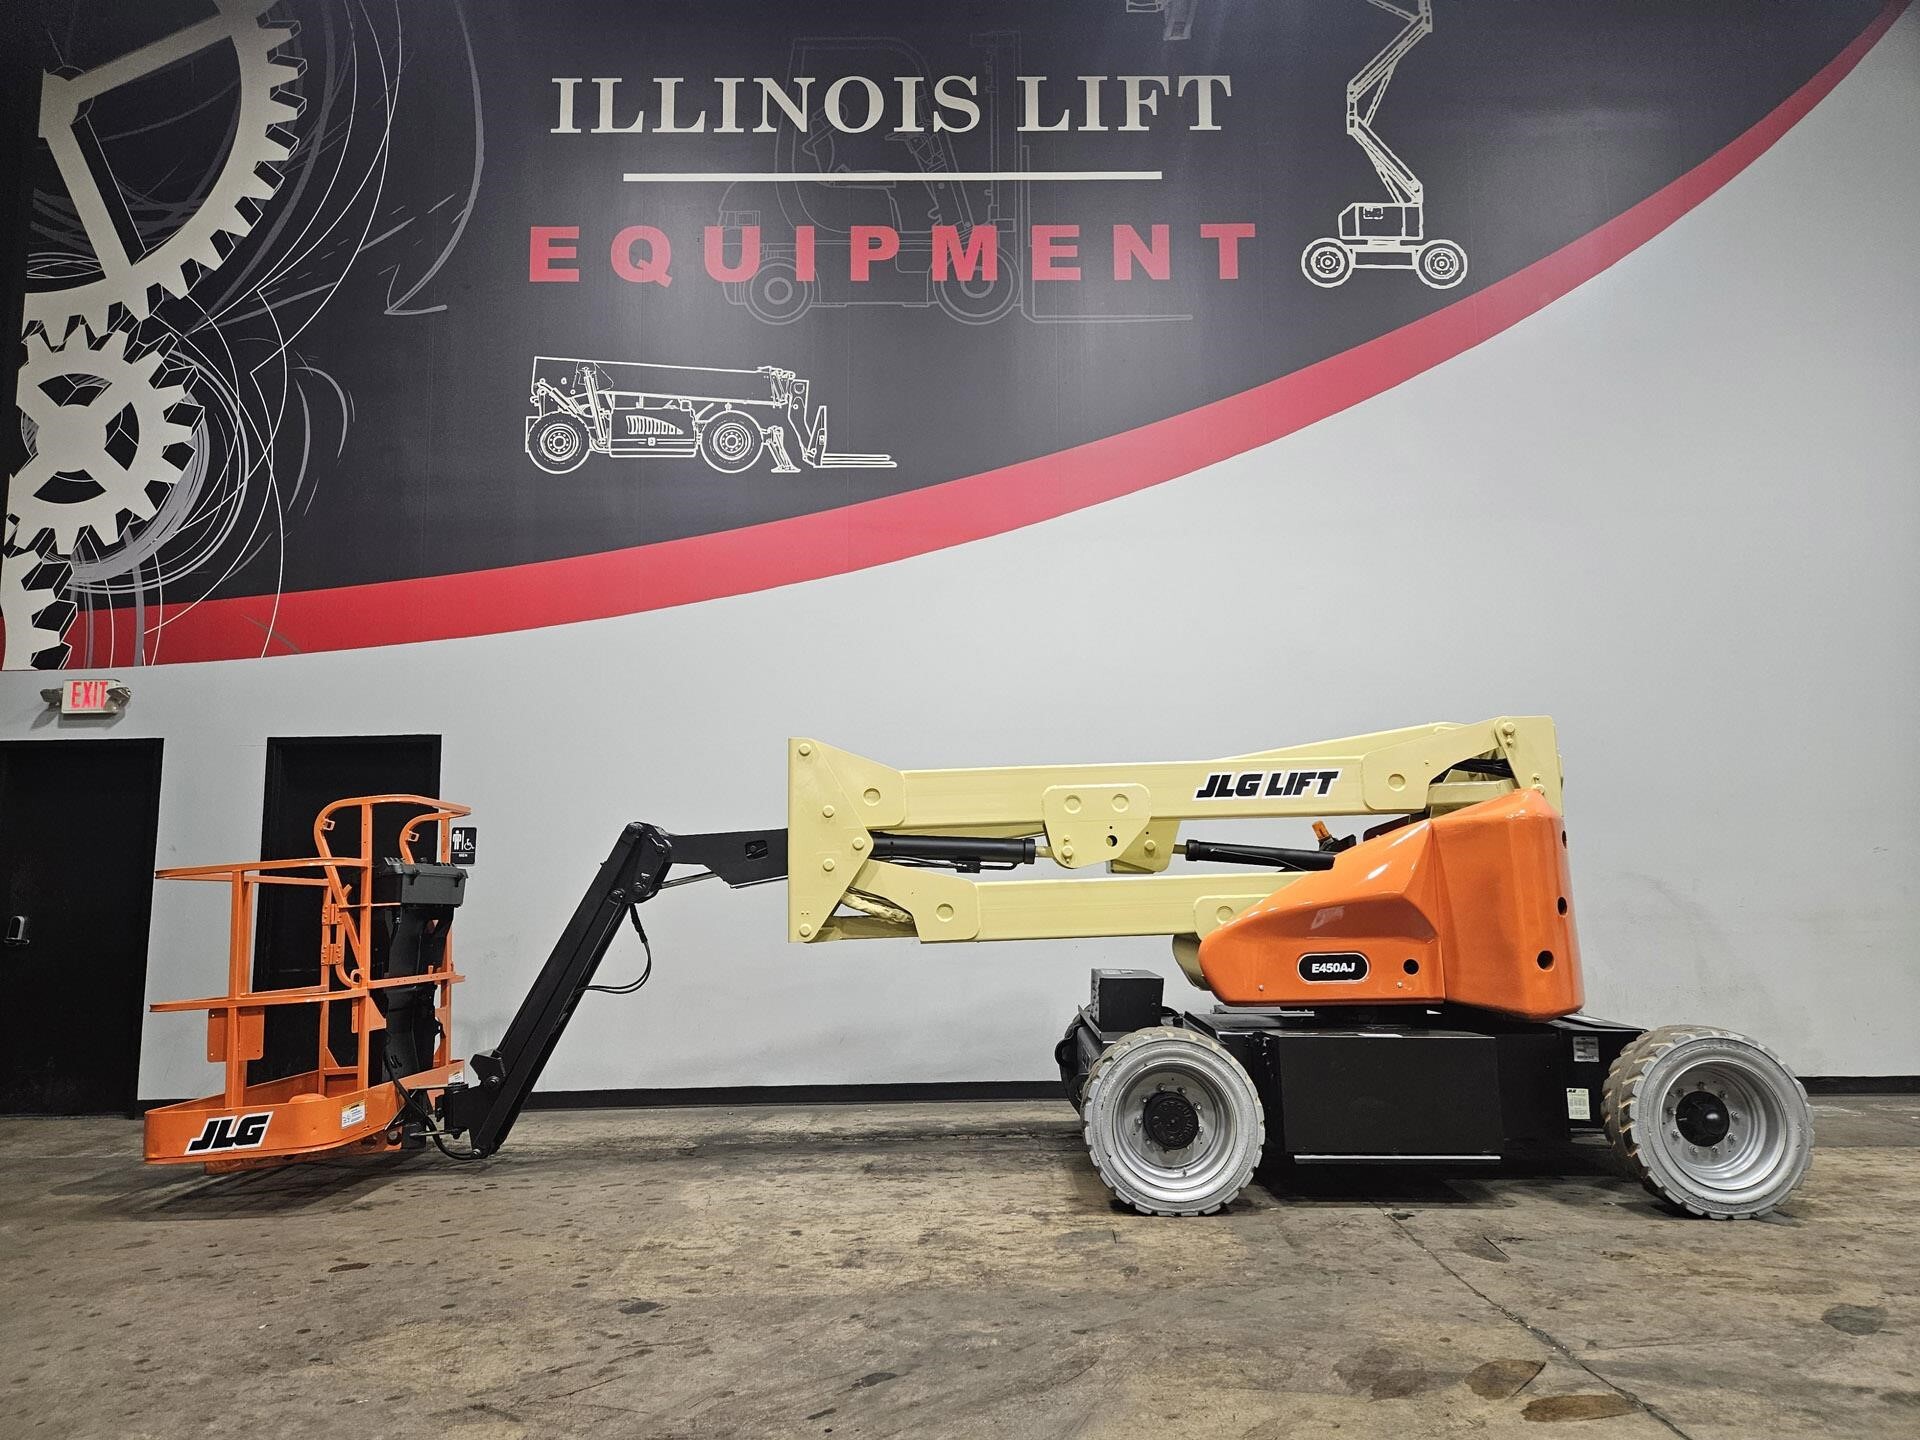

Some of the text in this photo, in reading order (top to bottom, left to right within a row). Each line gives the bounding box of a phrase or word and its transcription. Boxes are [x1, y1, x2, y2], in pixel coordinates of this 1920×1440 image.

[550, 75, 1232, 134] ILLINOIS LIFT
[529, 223, 1256, 287] EQUIPMENT
[71, 681, 108, 708] EXIT
[1196, 771, 1339, 798] JLG LIFT
[1311, 962, 1356, 973] E450AJ
[188, 1114, 270, 1152] JLG
